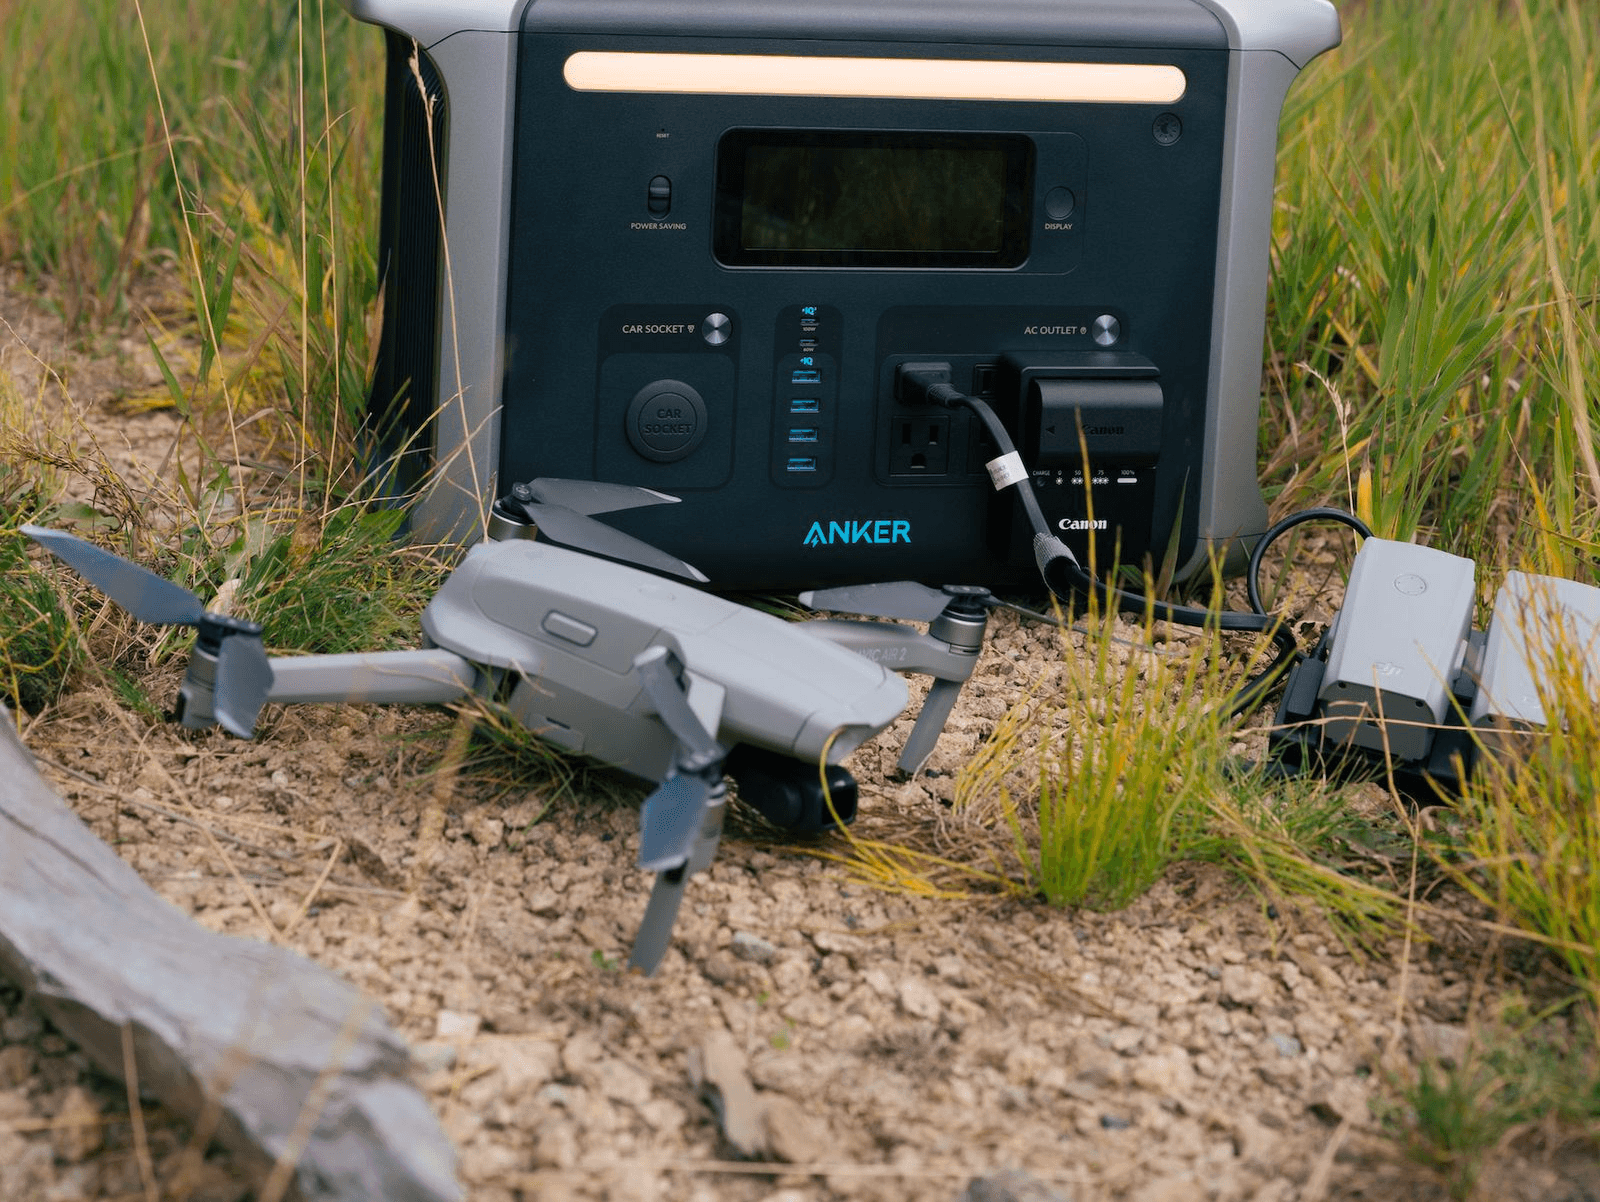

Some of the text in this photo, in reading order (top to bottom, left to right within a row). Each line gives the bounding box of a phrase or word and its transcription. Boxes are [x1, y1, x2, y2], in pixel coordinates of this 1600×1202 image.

[630, 222, 687, 230] POWER SAVING
[622, 324, 685, 334] CAR SOCKET
[1023, 326, 1077, 335] AC OUTLET
[657, 409, 682, 420] CAR
[645, 424, 692, 435] SOCKET
[1058, 518, 1107, 530] Canon
[803, 520, 912, 546] ANKER
[899, 647, 907, 661] 2
